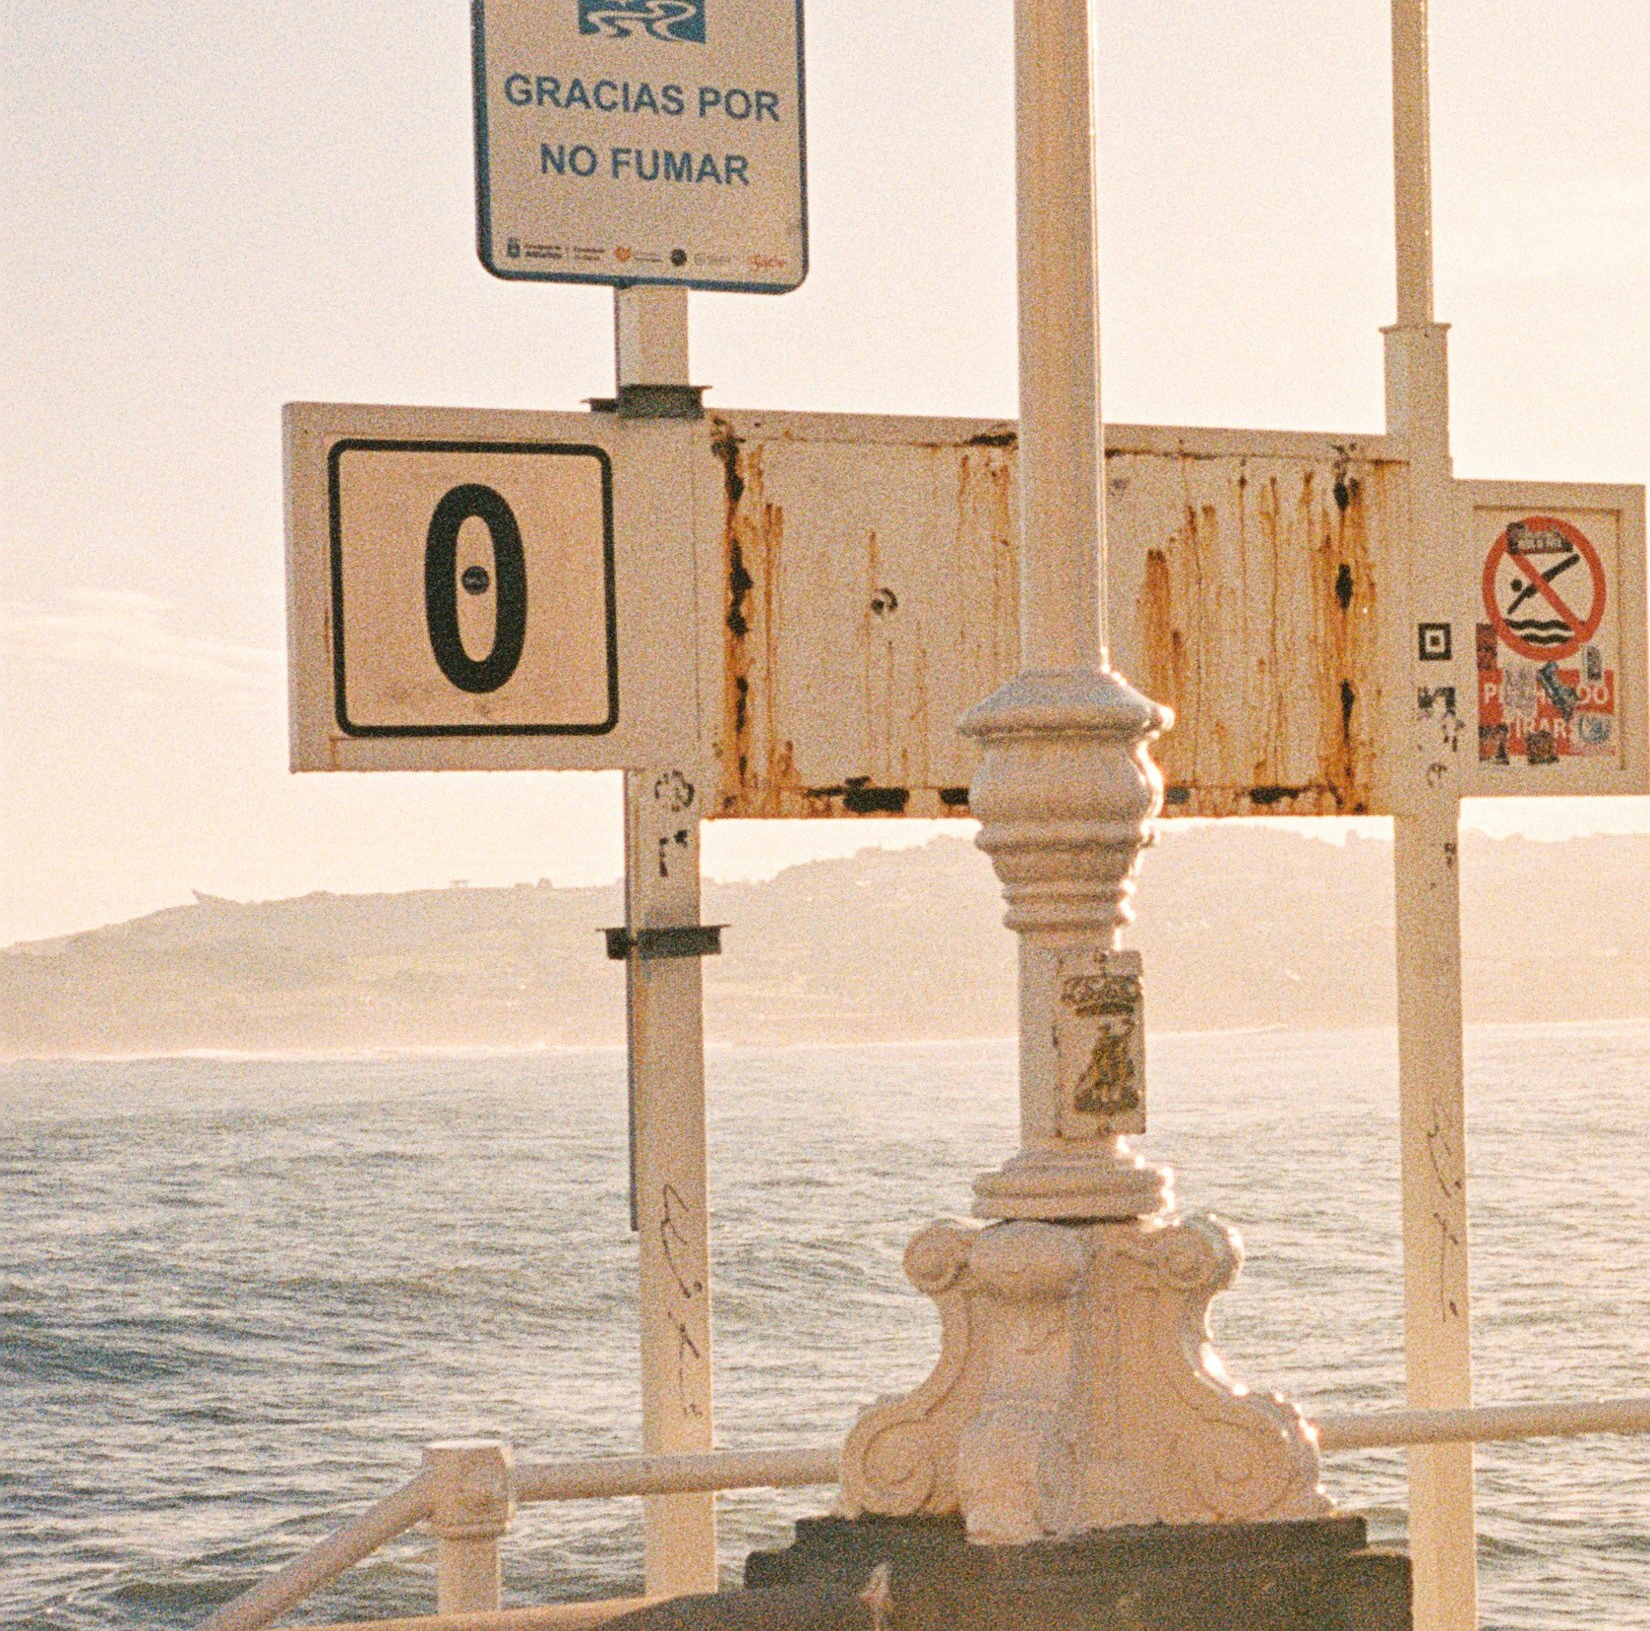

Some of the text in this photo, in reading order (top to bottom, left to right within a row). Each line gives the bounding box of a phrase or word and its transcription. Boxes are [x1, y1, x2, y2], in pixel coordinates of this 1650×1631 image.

[503, 72, 780, 123] GRACIAS POR
[539, 142, 750, 186] NO FUMAR
[424, 483, 528, 695] 0
